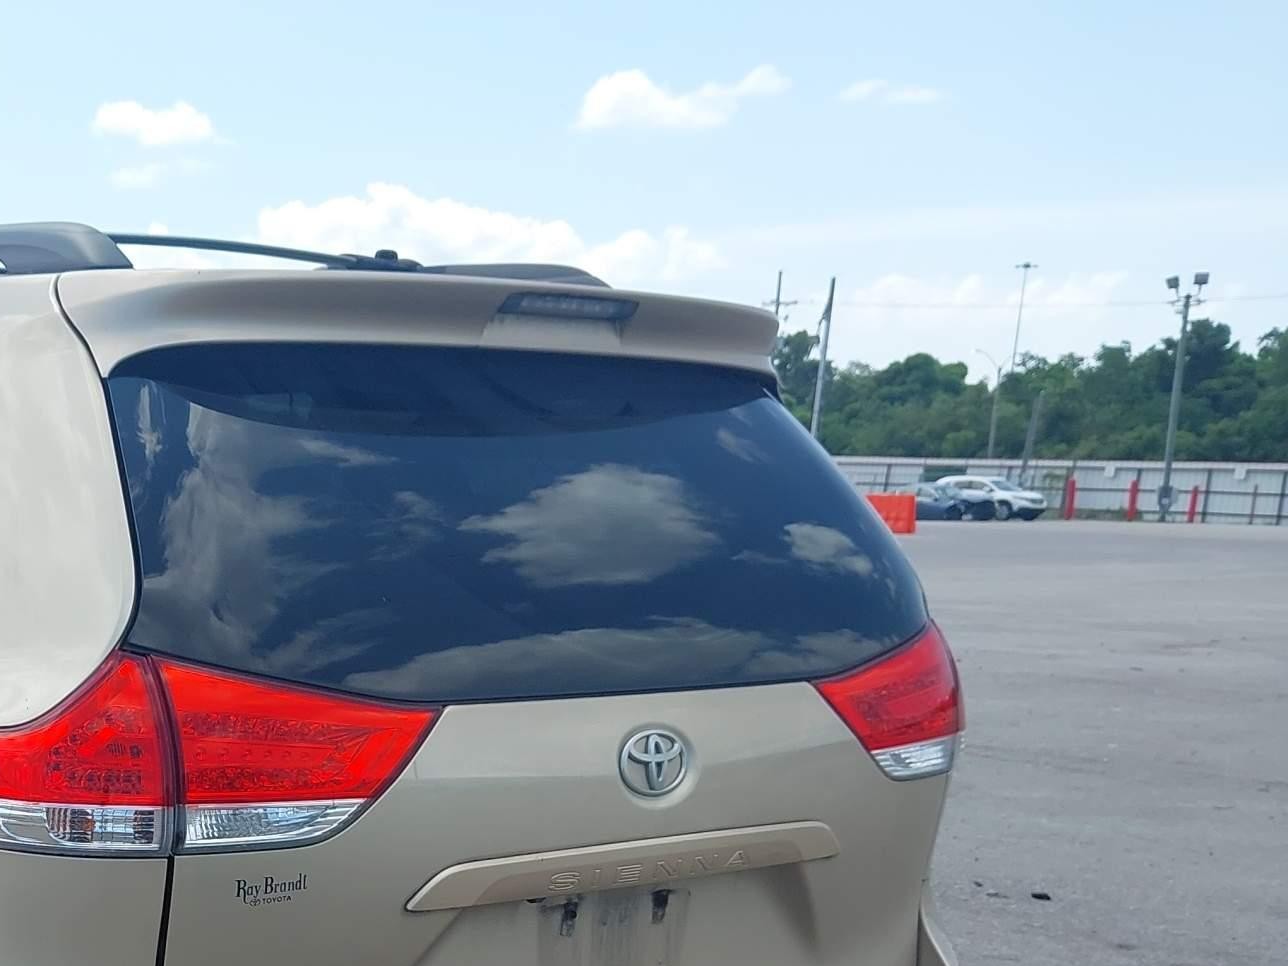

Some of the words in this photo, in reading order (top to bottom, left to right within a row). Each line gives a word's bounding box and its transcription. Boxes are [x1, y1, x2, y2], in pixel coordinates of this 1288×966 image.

[547, 850, 745, 892] SIENNA
[234, 879, 262, 905] Ray
[262, 895, 292, 905] TOYOTA
